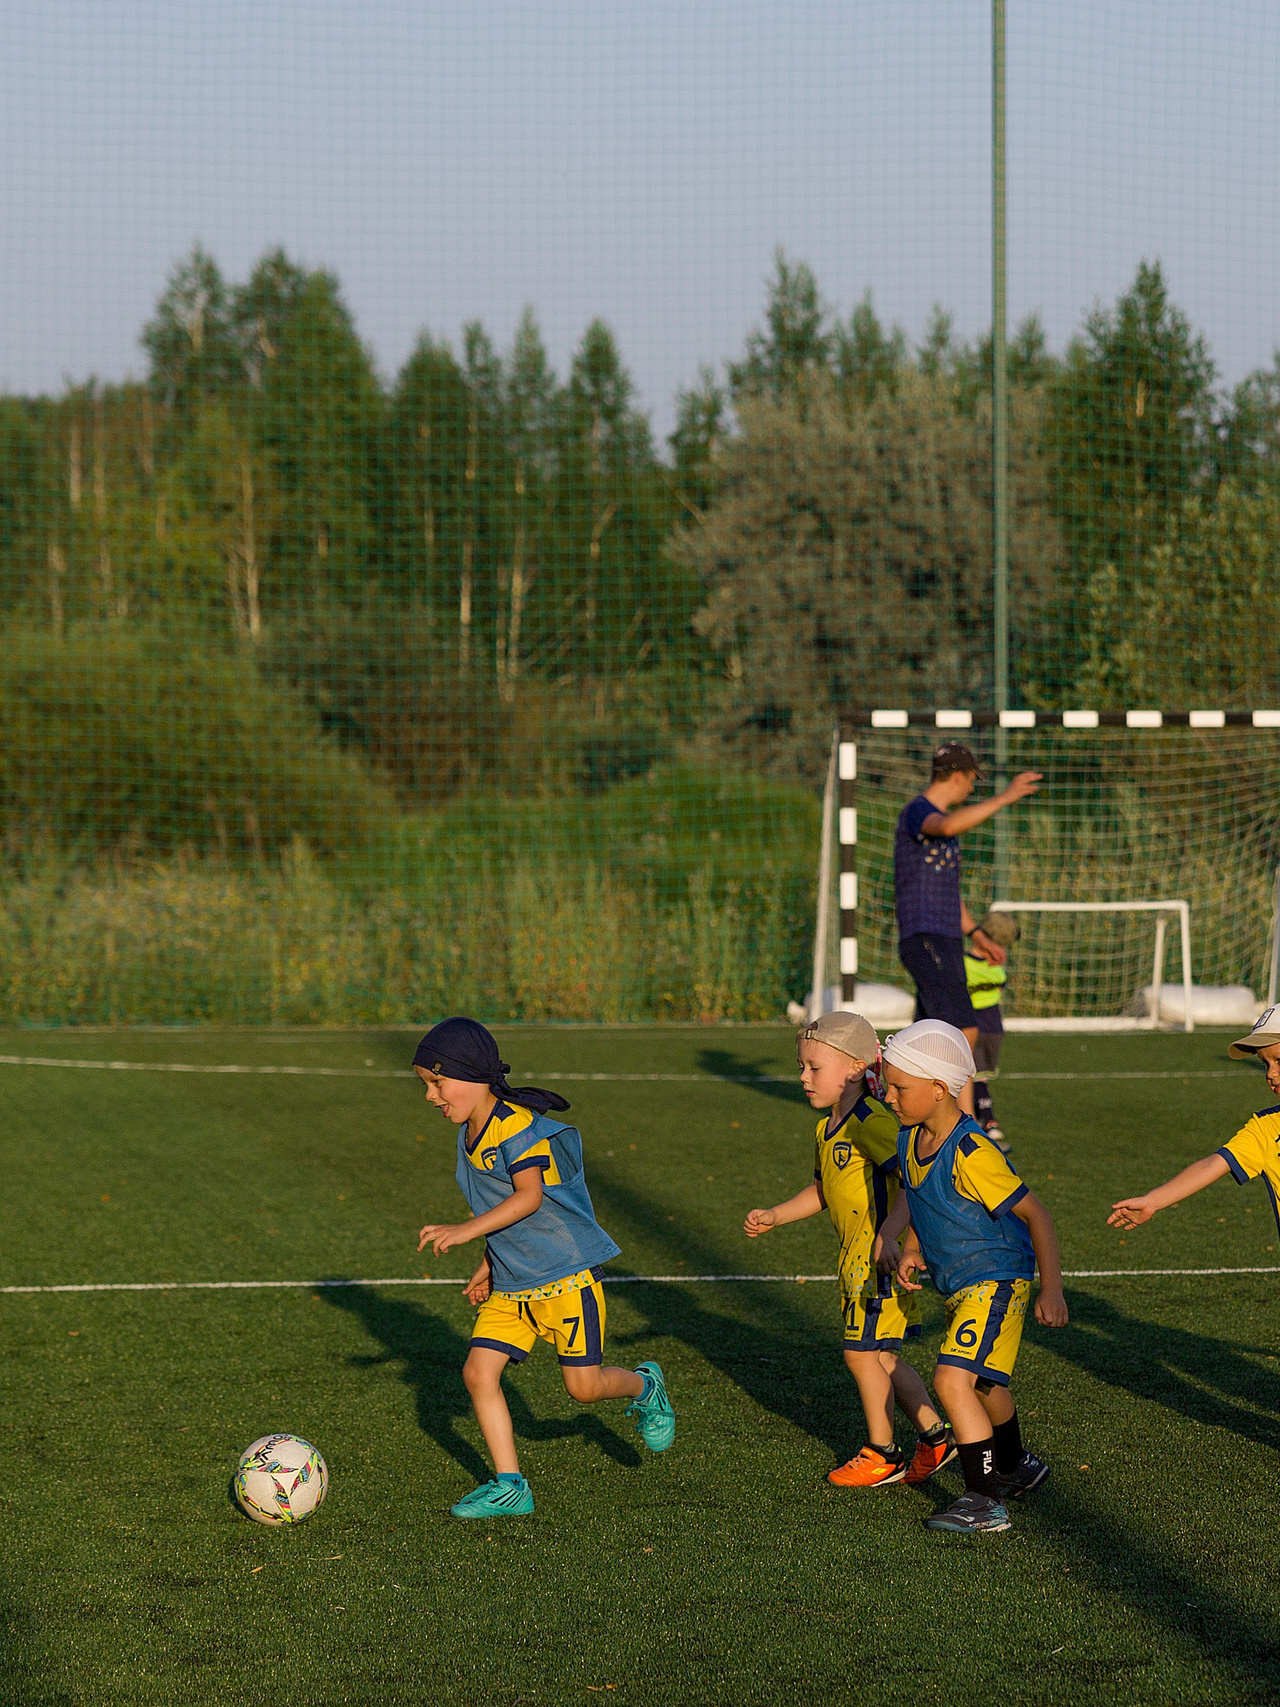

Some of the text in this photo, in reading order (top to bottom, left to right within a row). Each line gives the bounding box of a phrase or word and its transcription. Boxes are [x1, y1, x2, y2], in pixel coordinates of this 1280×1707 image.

[847, 1301, 859, 1330] 1
[563, 1316, 580, 1347] 7
[955, 1319, 977, 1347] 6
[256, 1435, 285, 1468] VAMO
[982, 1450, 992, 1475] FILA
